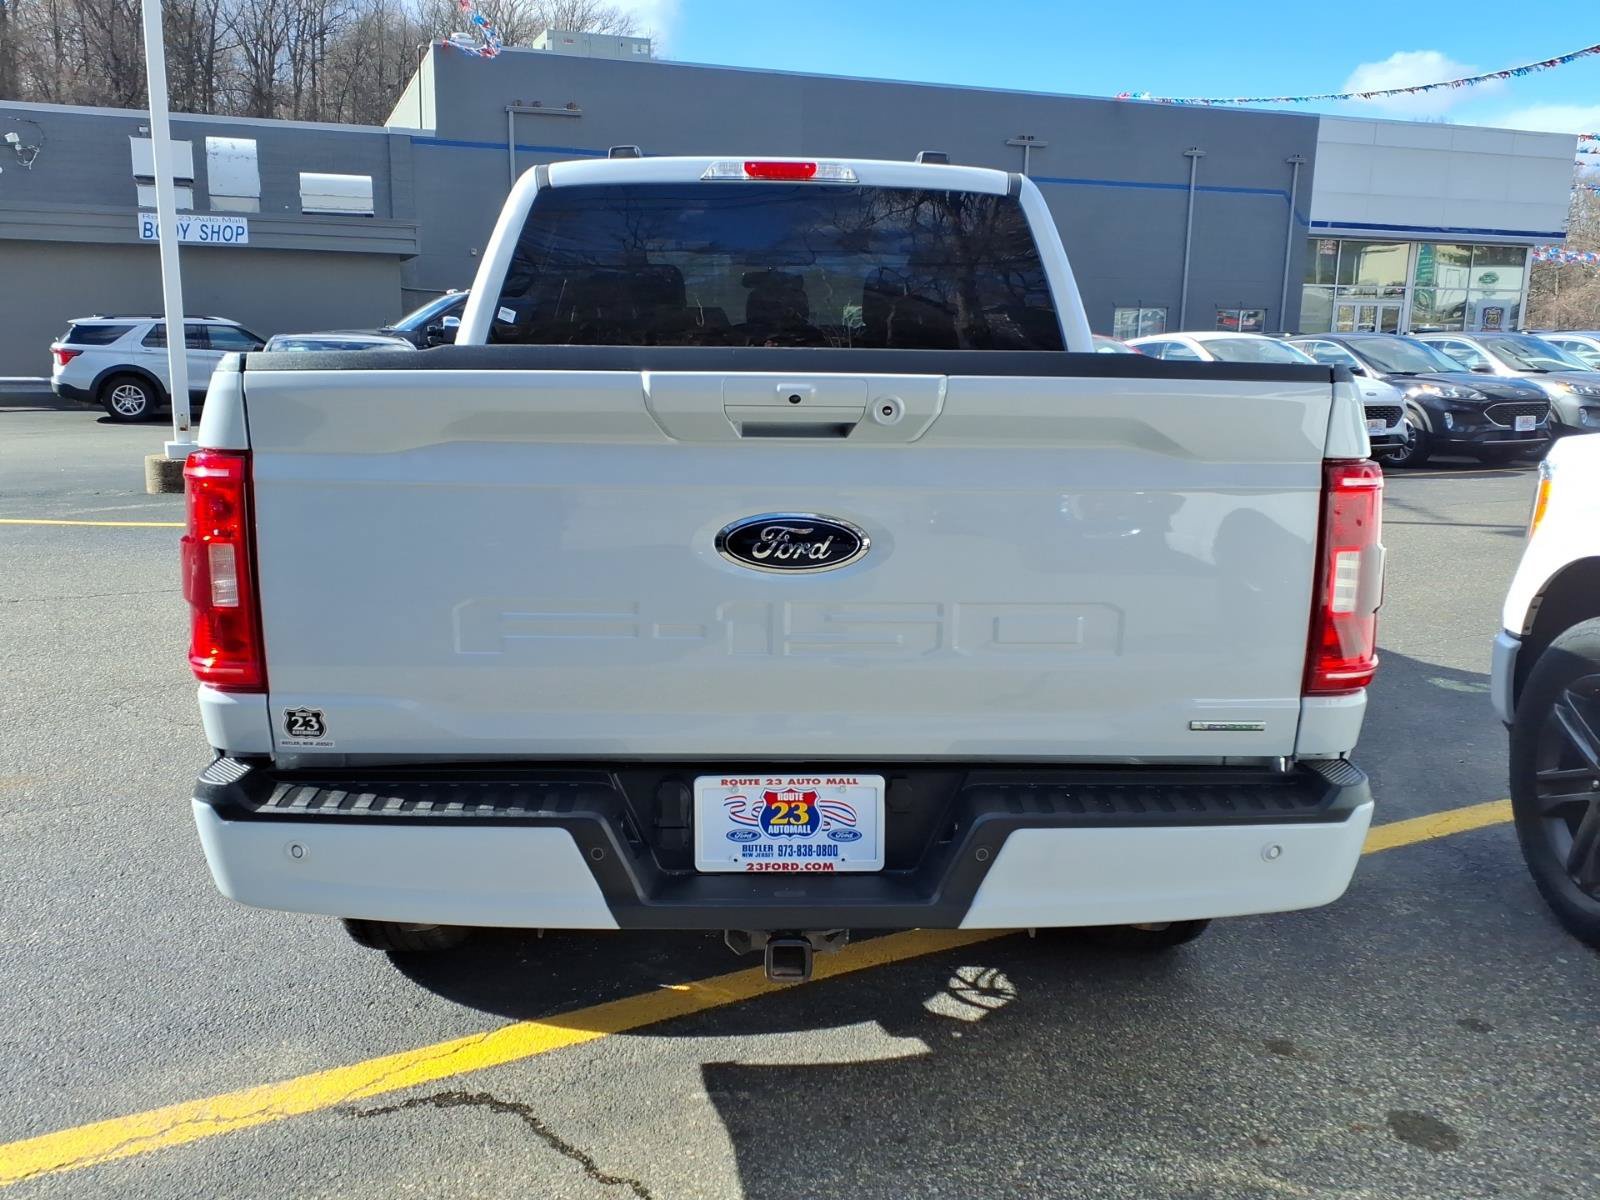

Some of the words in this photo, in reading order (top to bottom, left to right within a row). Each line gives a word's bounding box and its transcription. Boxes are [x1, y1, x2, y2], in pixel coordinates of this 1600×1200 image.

[143, 221, 190, 240] BY
[200, 223, 245, 242] SHOP
[752, 526, 834, 559] Ford
[291, 716, 319, 731] 23
[777, 792, 804, 801] ROUTE
[770, 802, 809, 825] 23
[768, 825, 812, 834] AUTOMALL
[742, 844, 774, 853] BUTLER
[778, 844, 838, 857] 973-838-0800
[746, 862, 834, 871] 23FORD.COM
